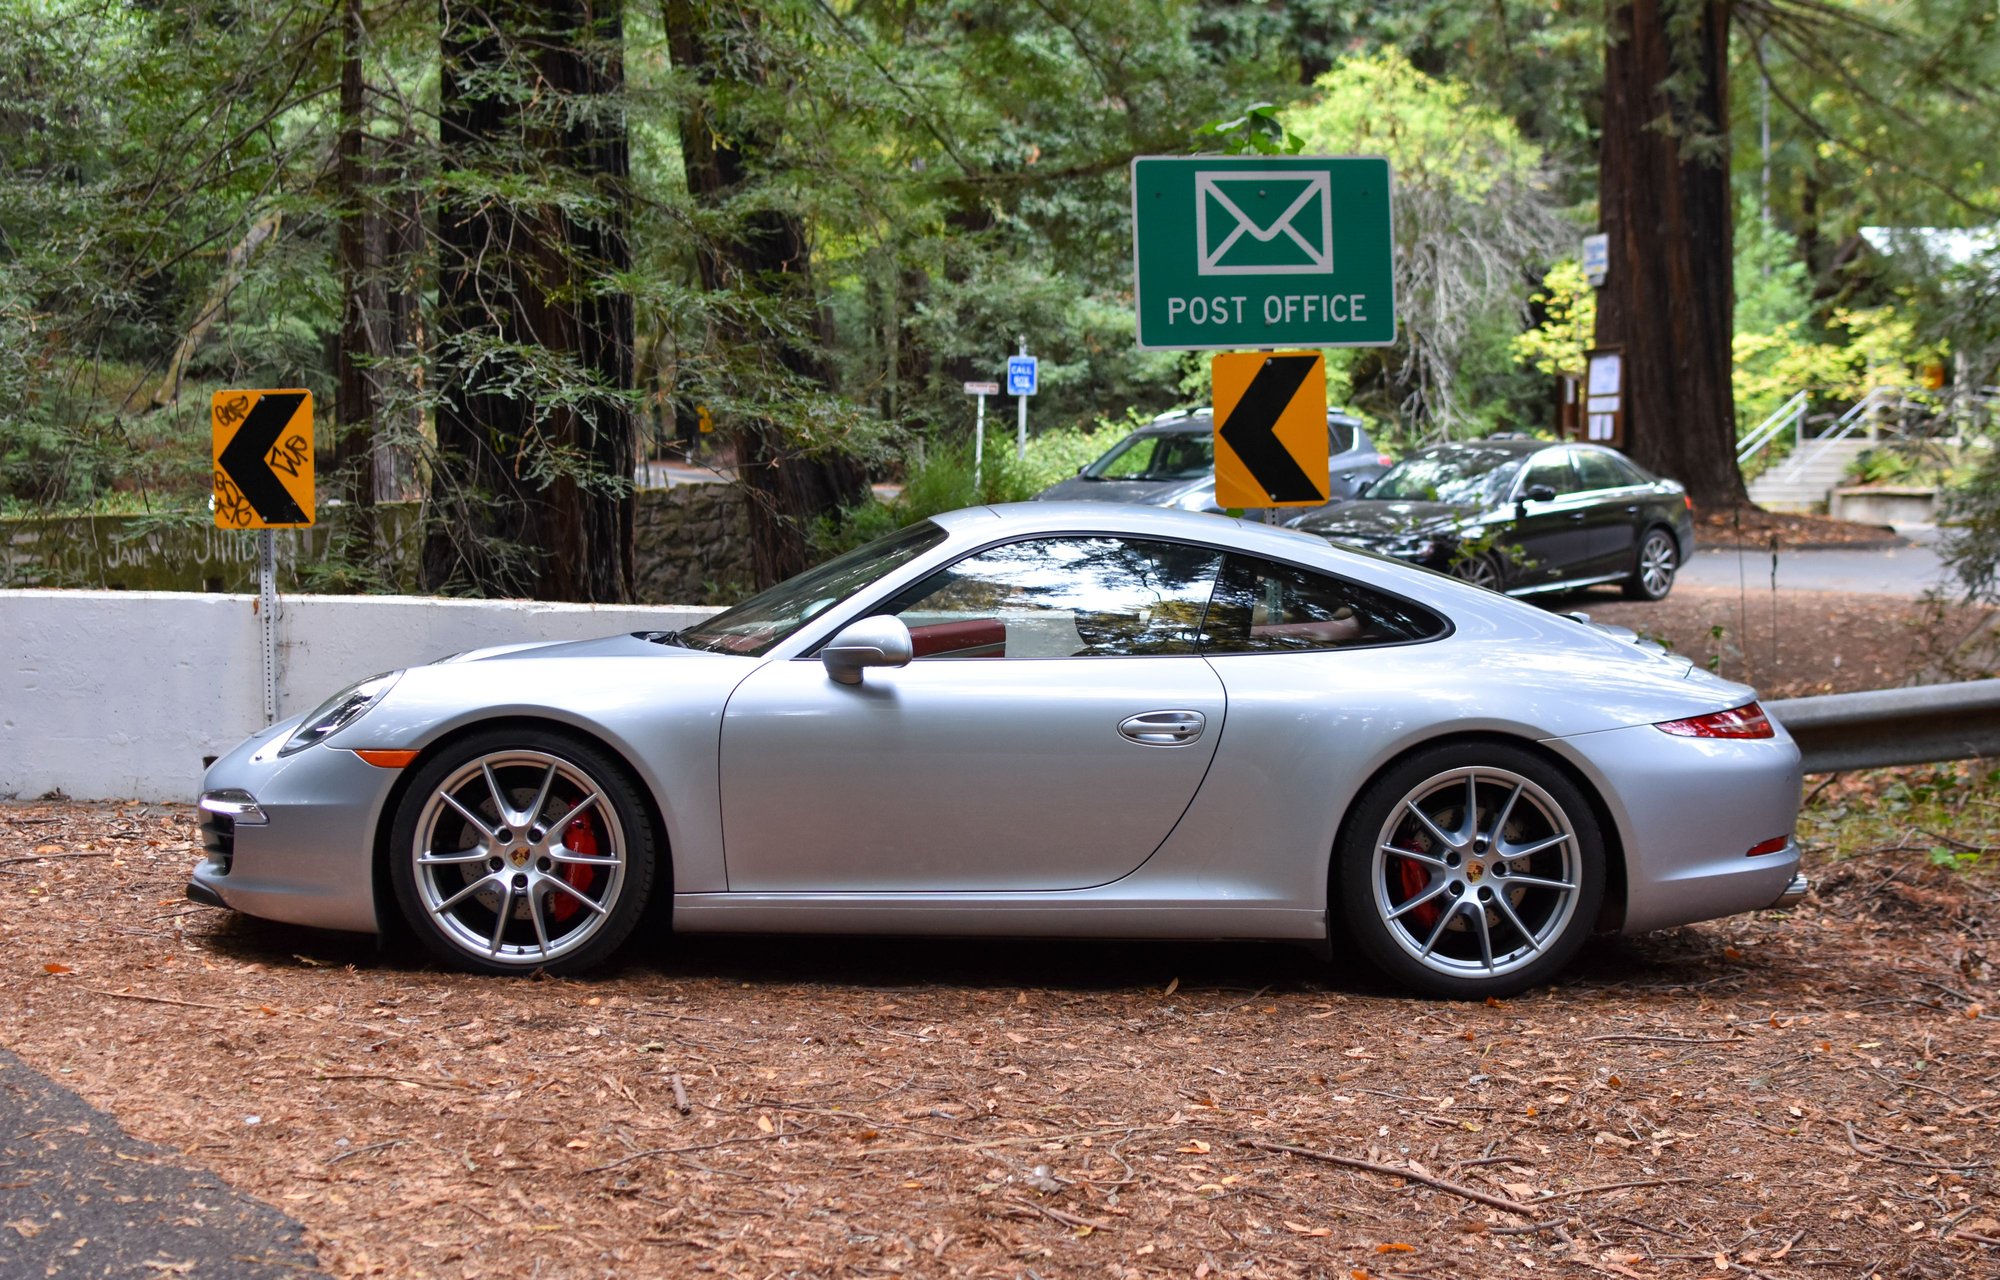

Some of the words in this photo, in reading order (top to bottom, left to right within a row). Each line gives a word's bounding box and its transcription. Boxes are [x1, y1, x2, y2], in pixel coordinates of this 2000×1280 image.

[1167, 296, 1248, 325] POST
[1263, 294, 1368, 324] OFFICE
[1010, 364, 1032, 375] CALL
